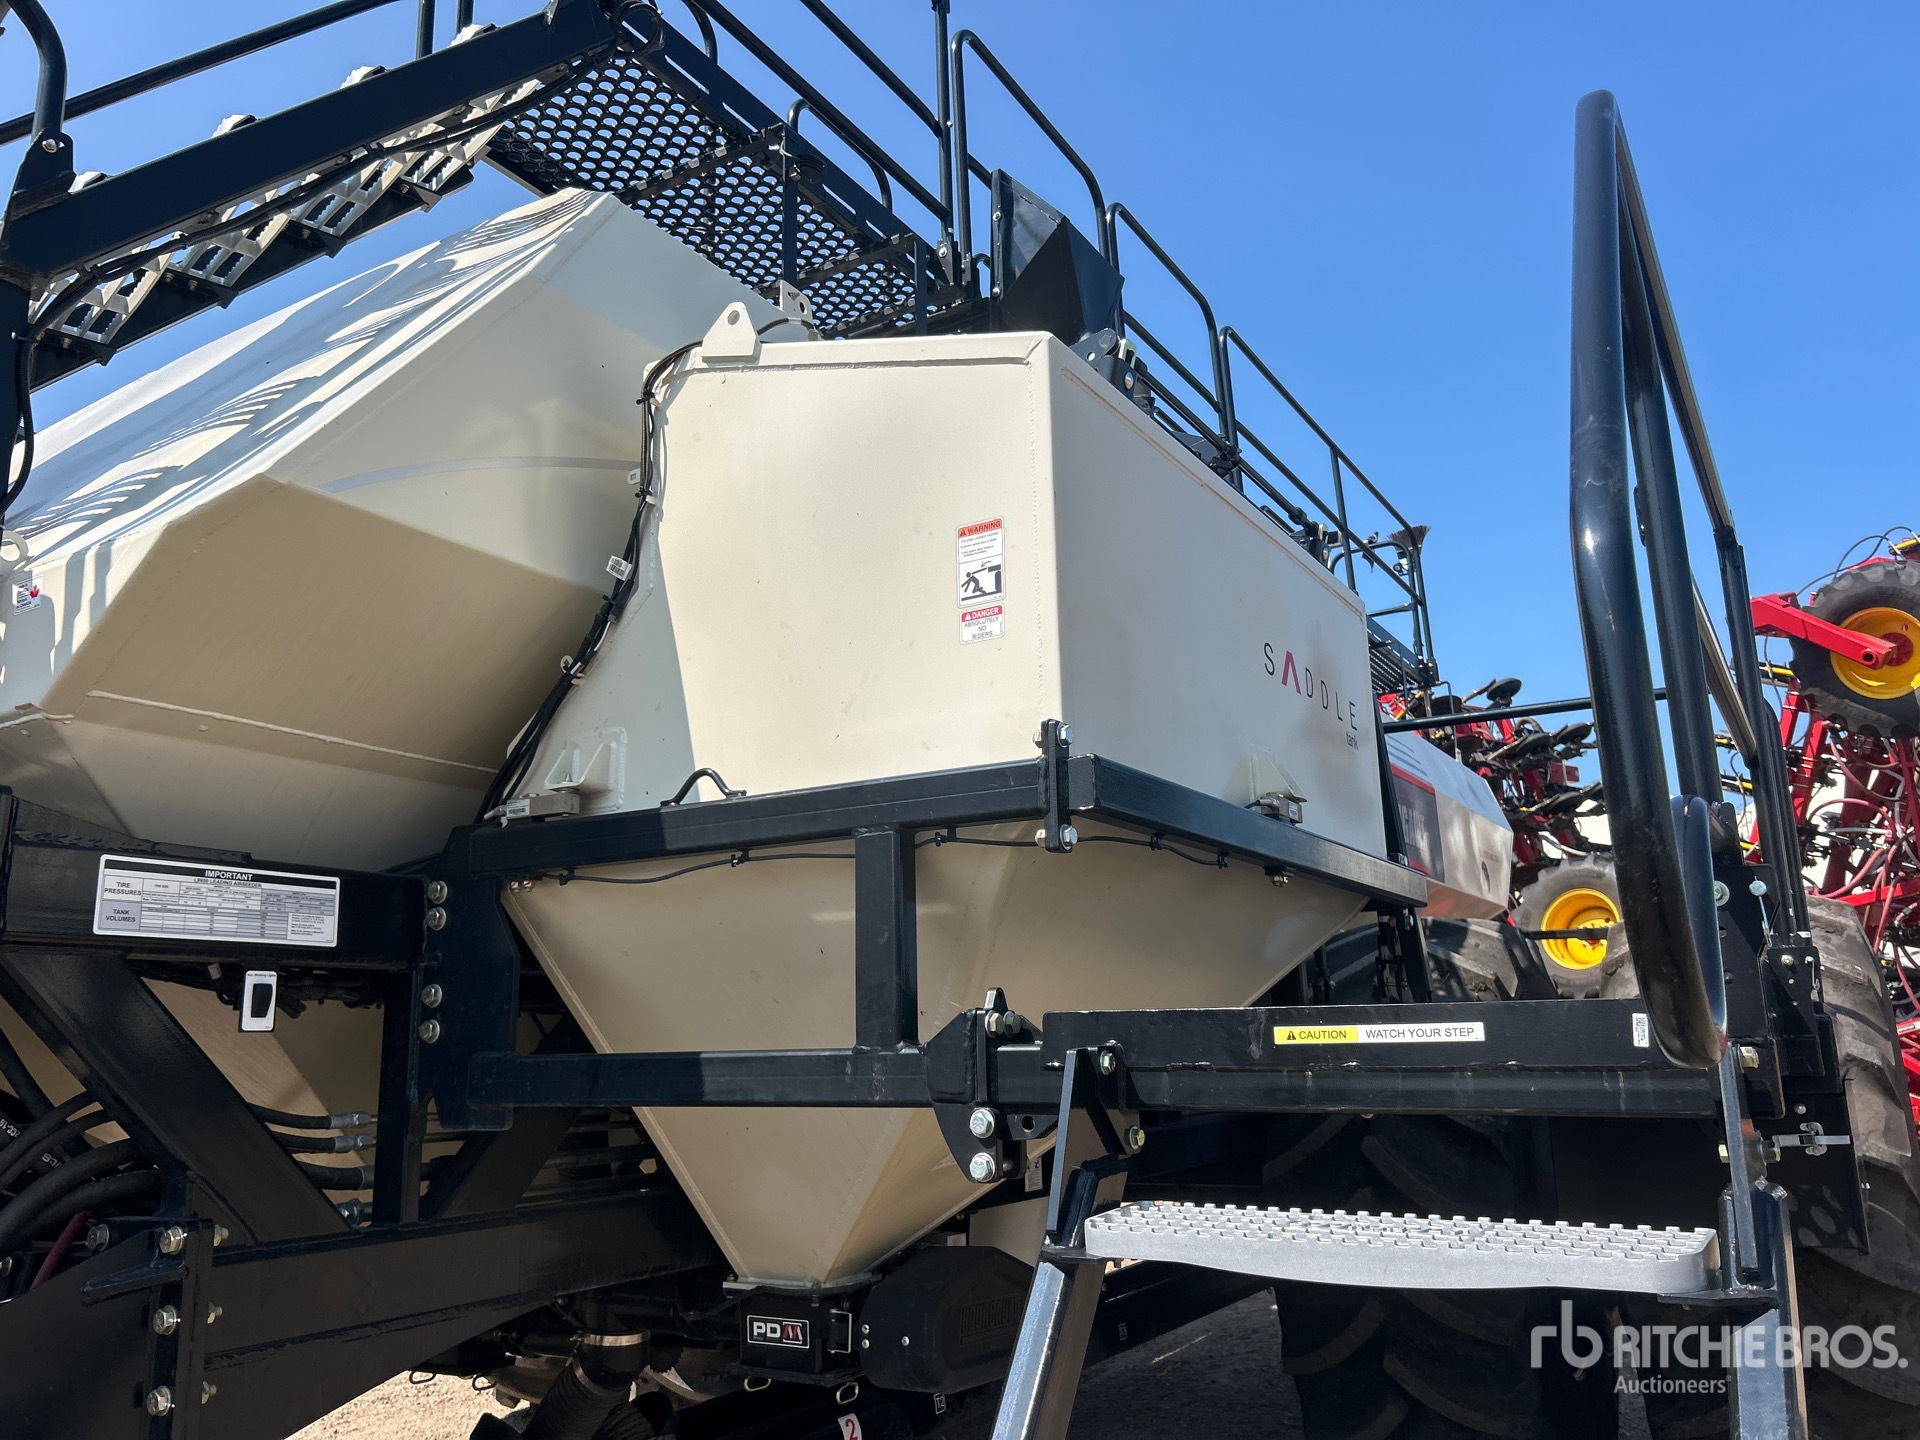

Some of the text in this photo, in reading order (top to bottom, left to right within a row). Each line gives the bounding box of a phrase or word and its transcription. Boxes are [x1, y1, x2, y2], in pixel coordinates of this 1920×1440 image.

[967, 521, 1001, 534] WARNING
[972, 607, 999, 619] DANGER
[964, 616, 999, 628] ABSOLUTELY
[972, 631, 993, 640] RIDERS
[1264, 642, 1358, 731] SADDLE
[205, 870, 253, 881] IMPORTANT
[104, 888, 141, 896] PRESSURES
[1299, 1027, 1475, 1040] CAUTION WATCH YOUR STEP
[753, 1321, 803, 1343] PDM
[845, 1418, 858, 1440] 2
